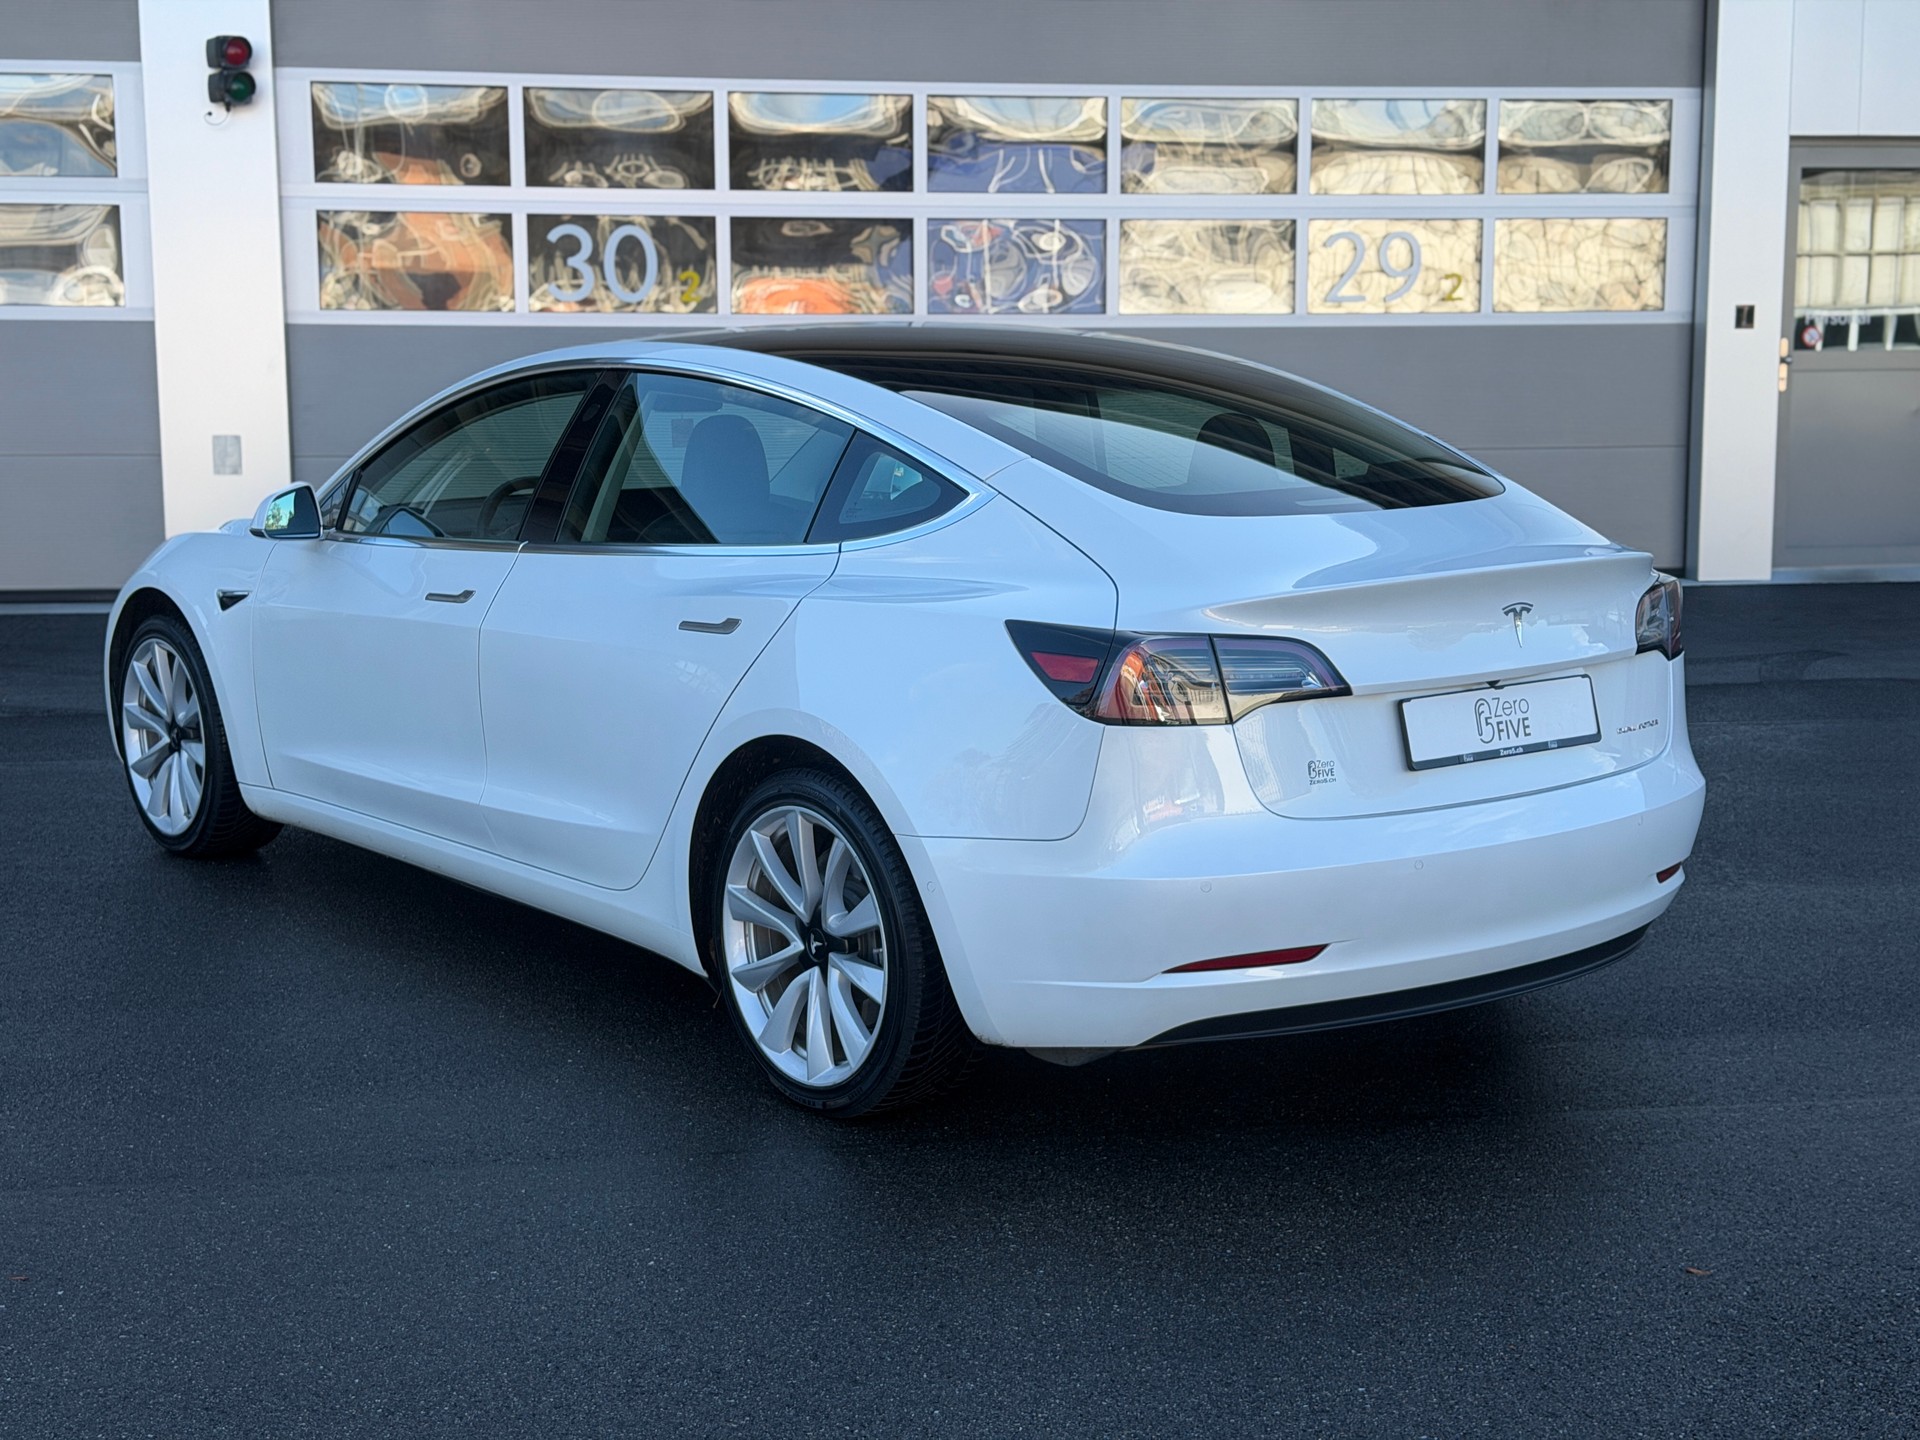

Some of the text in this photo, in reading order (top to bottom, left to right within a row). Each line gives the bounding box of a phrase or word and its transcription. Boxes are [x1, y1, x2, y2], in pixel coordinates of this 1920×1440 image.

[547, 223, 659, 303] 30
[1322, 231, 1422, 303] 29
[679, 270, 700, 303] 2
[1444, 273, 1463, 301] 2
[1804, 309, 1872, 326] Prsoal
[1491, 697, 1530, 719] Zero
[1496, 717, 1532, 742] FIVE
[1499, 746, 1525, 757] Zero5.ch
[1316, 759, 1336, 769] Zero
[1317, 767, 1336, 779] FIVE
